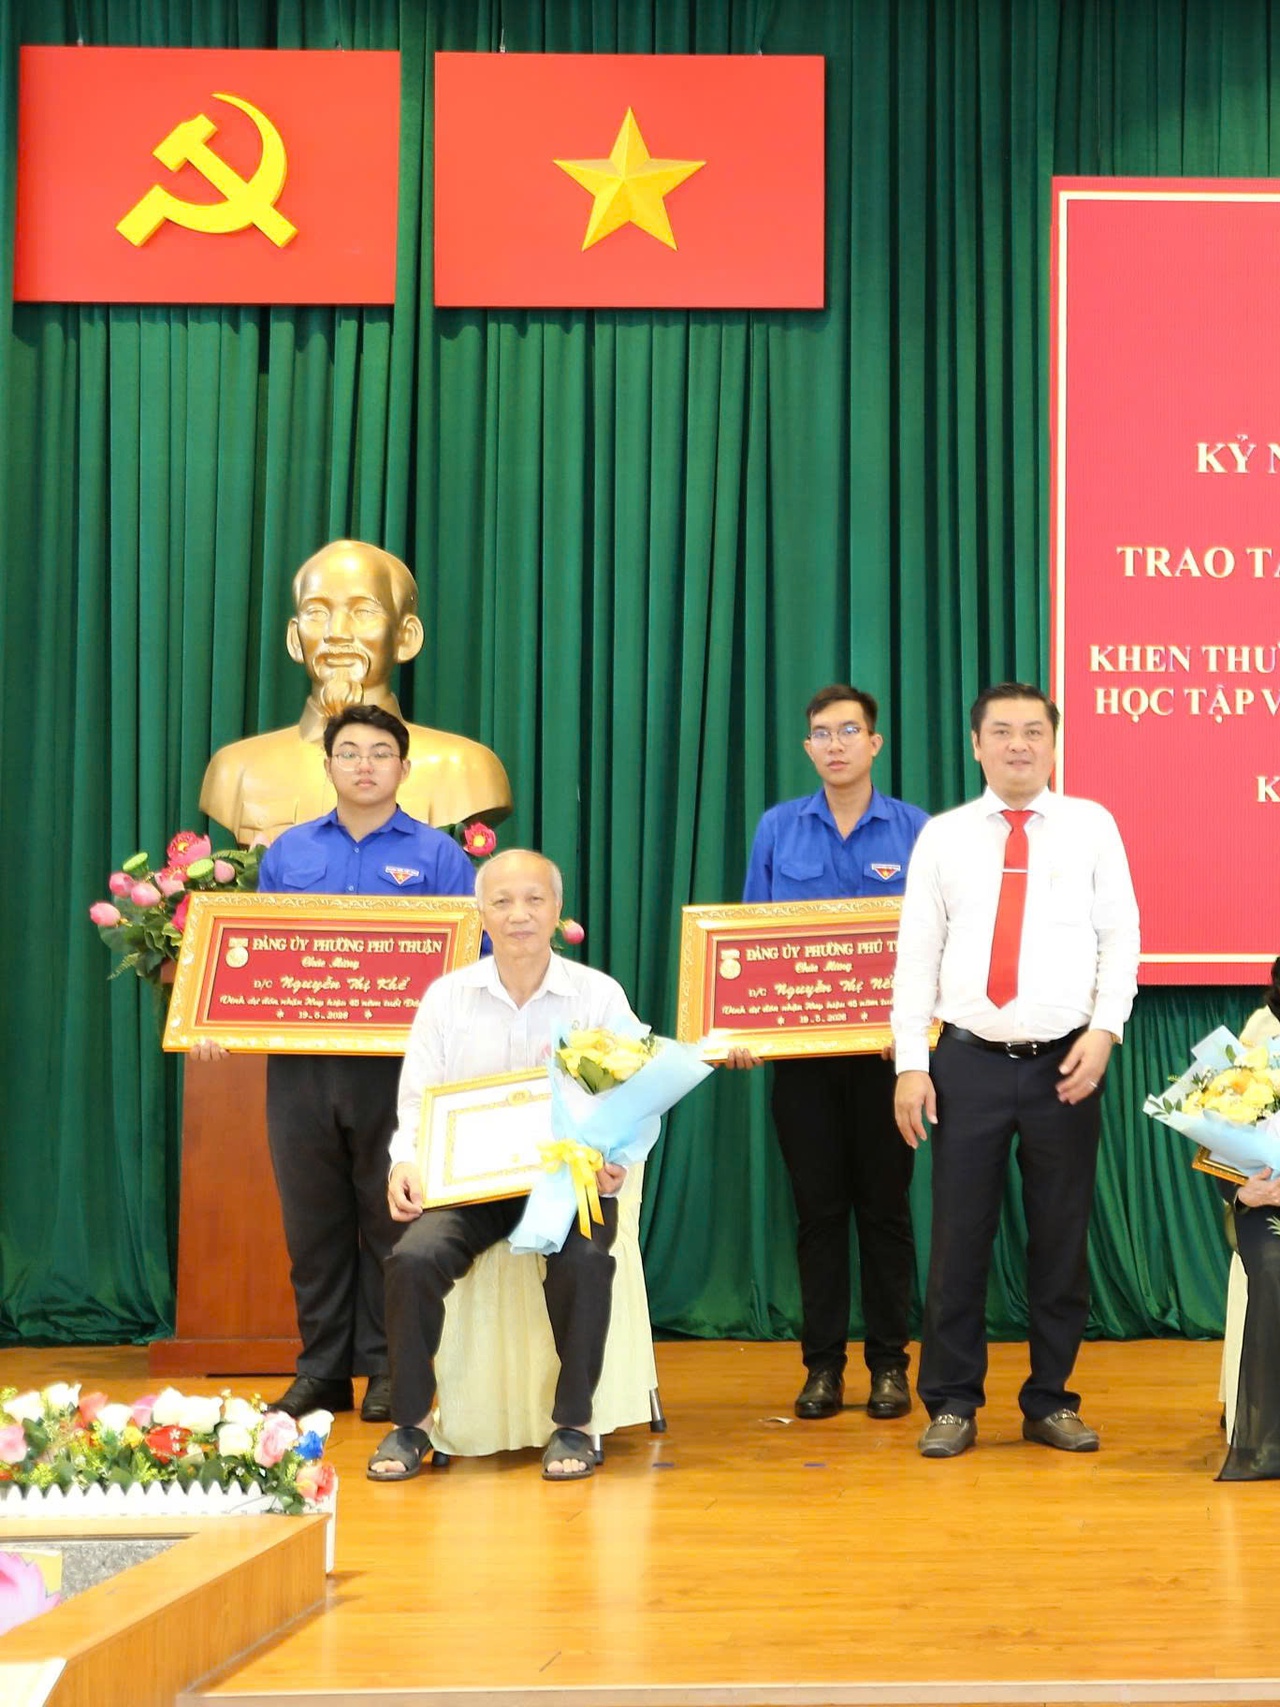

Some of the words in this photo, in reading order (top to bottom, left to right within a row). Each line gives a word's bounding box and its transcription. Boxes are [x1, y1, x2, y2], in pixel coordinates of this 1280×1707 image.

[1197, 433, 1257, 475] KỶ
[1117, 546, 1235, 579] TRAO
[1090, 644, 1191, 674] KHEN
[1095, 687, 1174, 723] HỌC
[1184, 684, 1255, 724] TẬP
